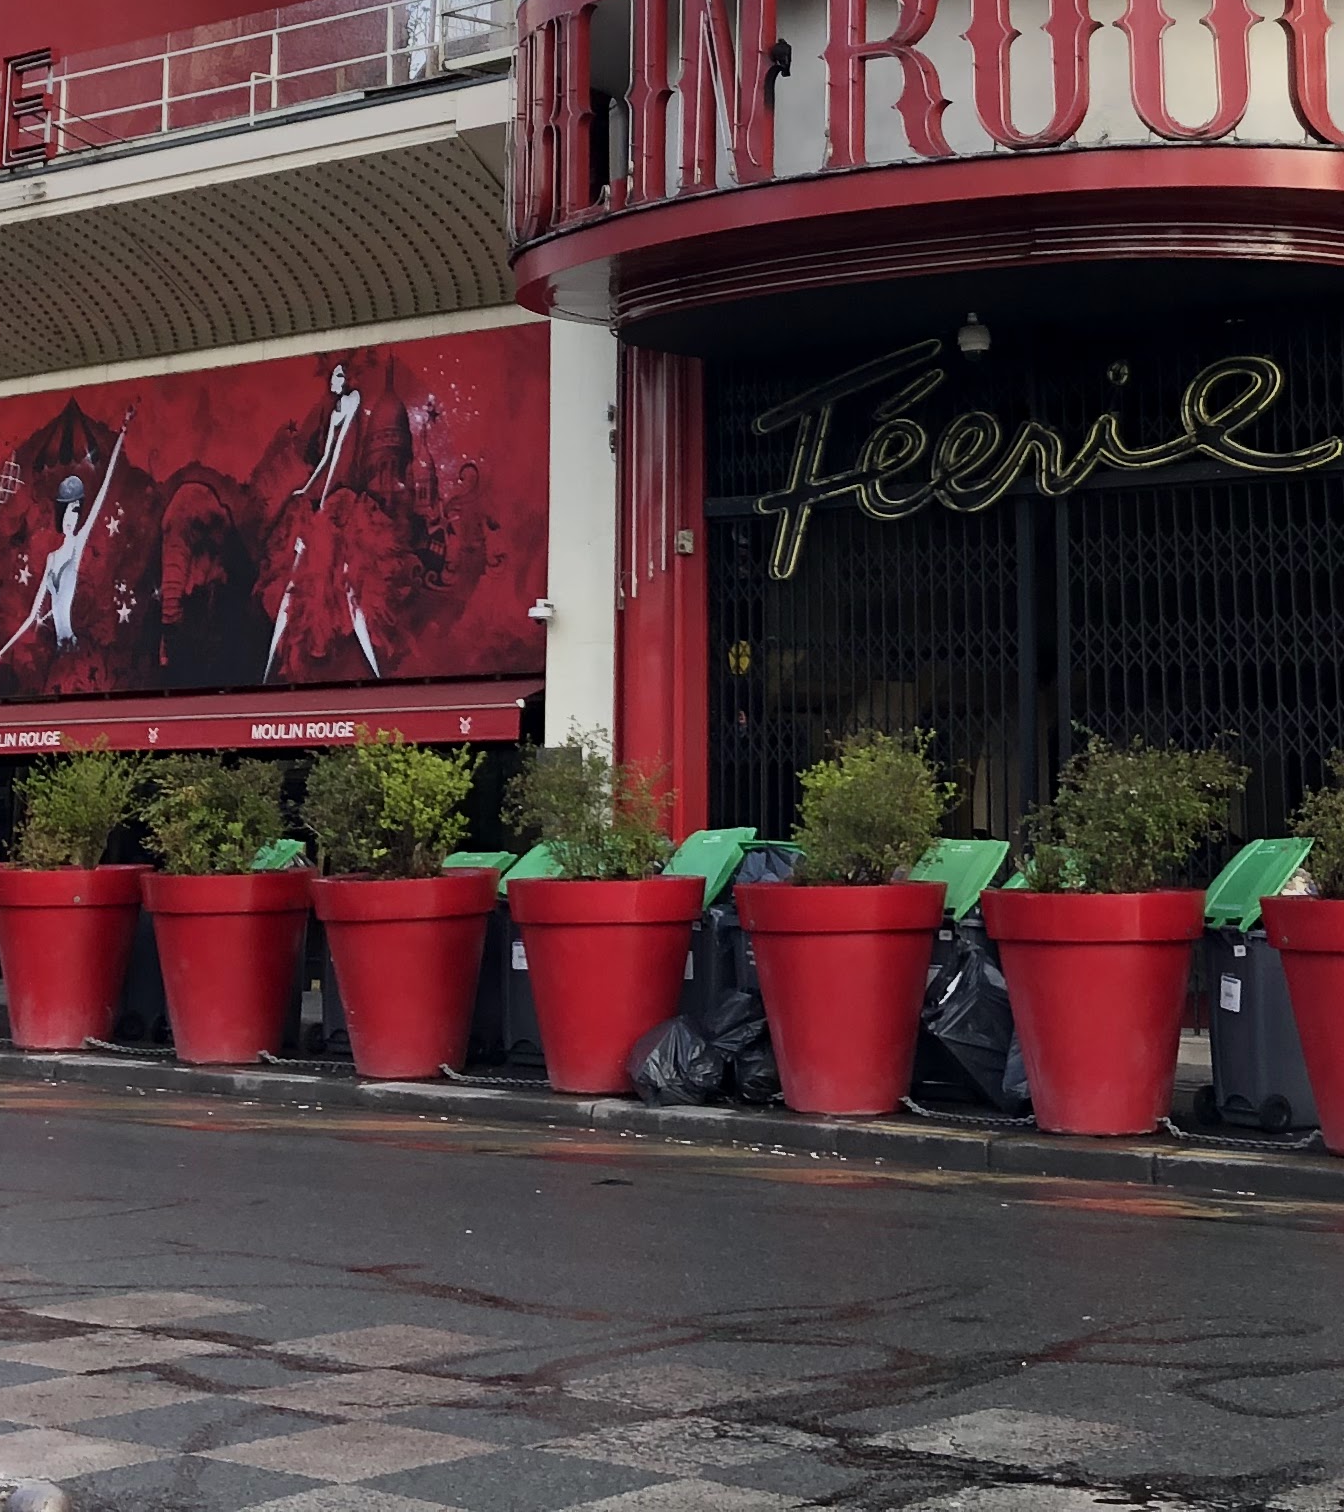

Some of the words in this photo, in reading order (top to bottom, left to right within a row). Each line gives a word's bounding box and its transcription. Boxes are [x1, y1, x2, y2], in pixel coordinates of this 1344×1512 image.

[251, 723, 304, 739] MOULIN
[305, 721, 355, 738] ROUGE
[18, 731, 61, 747] ROUGE
